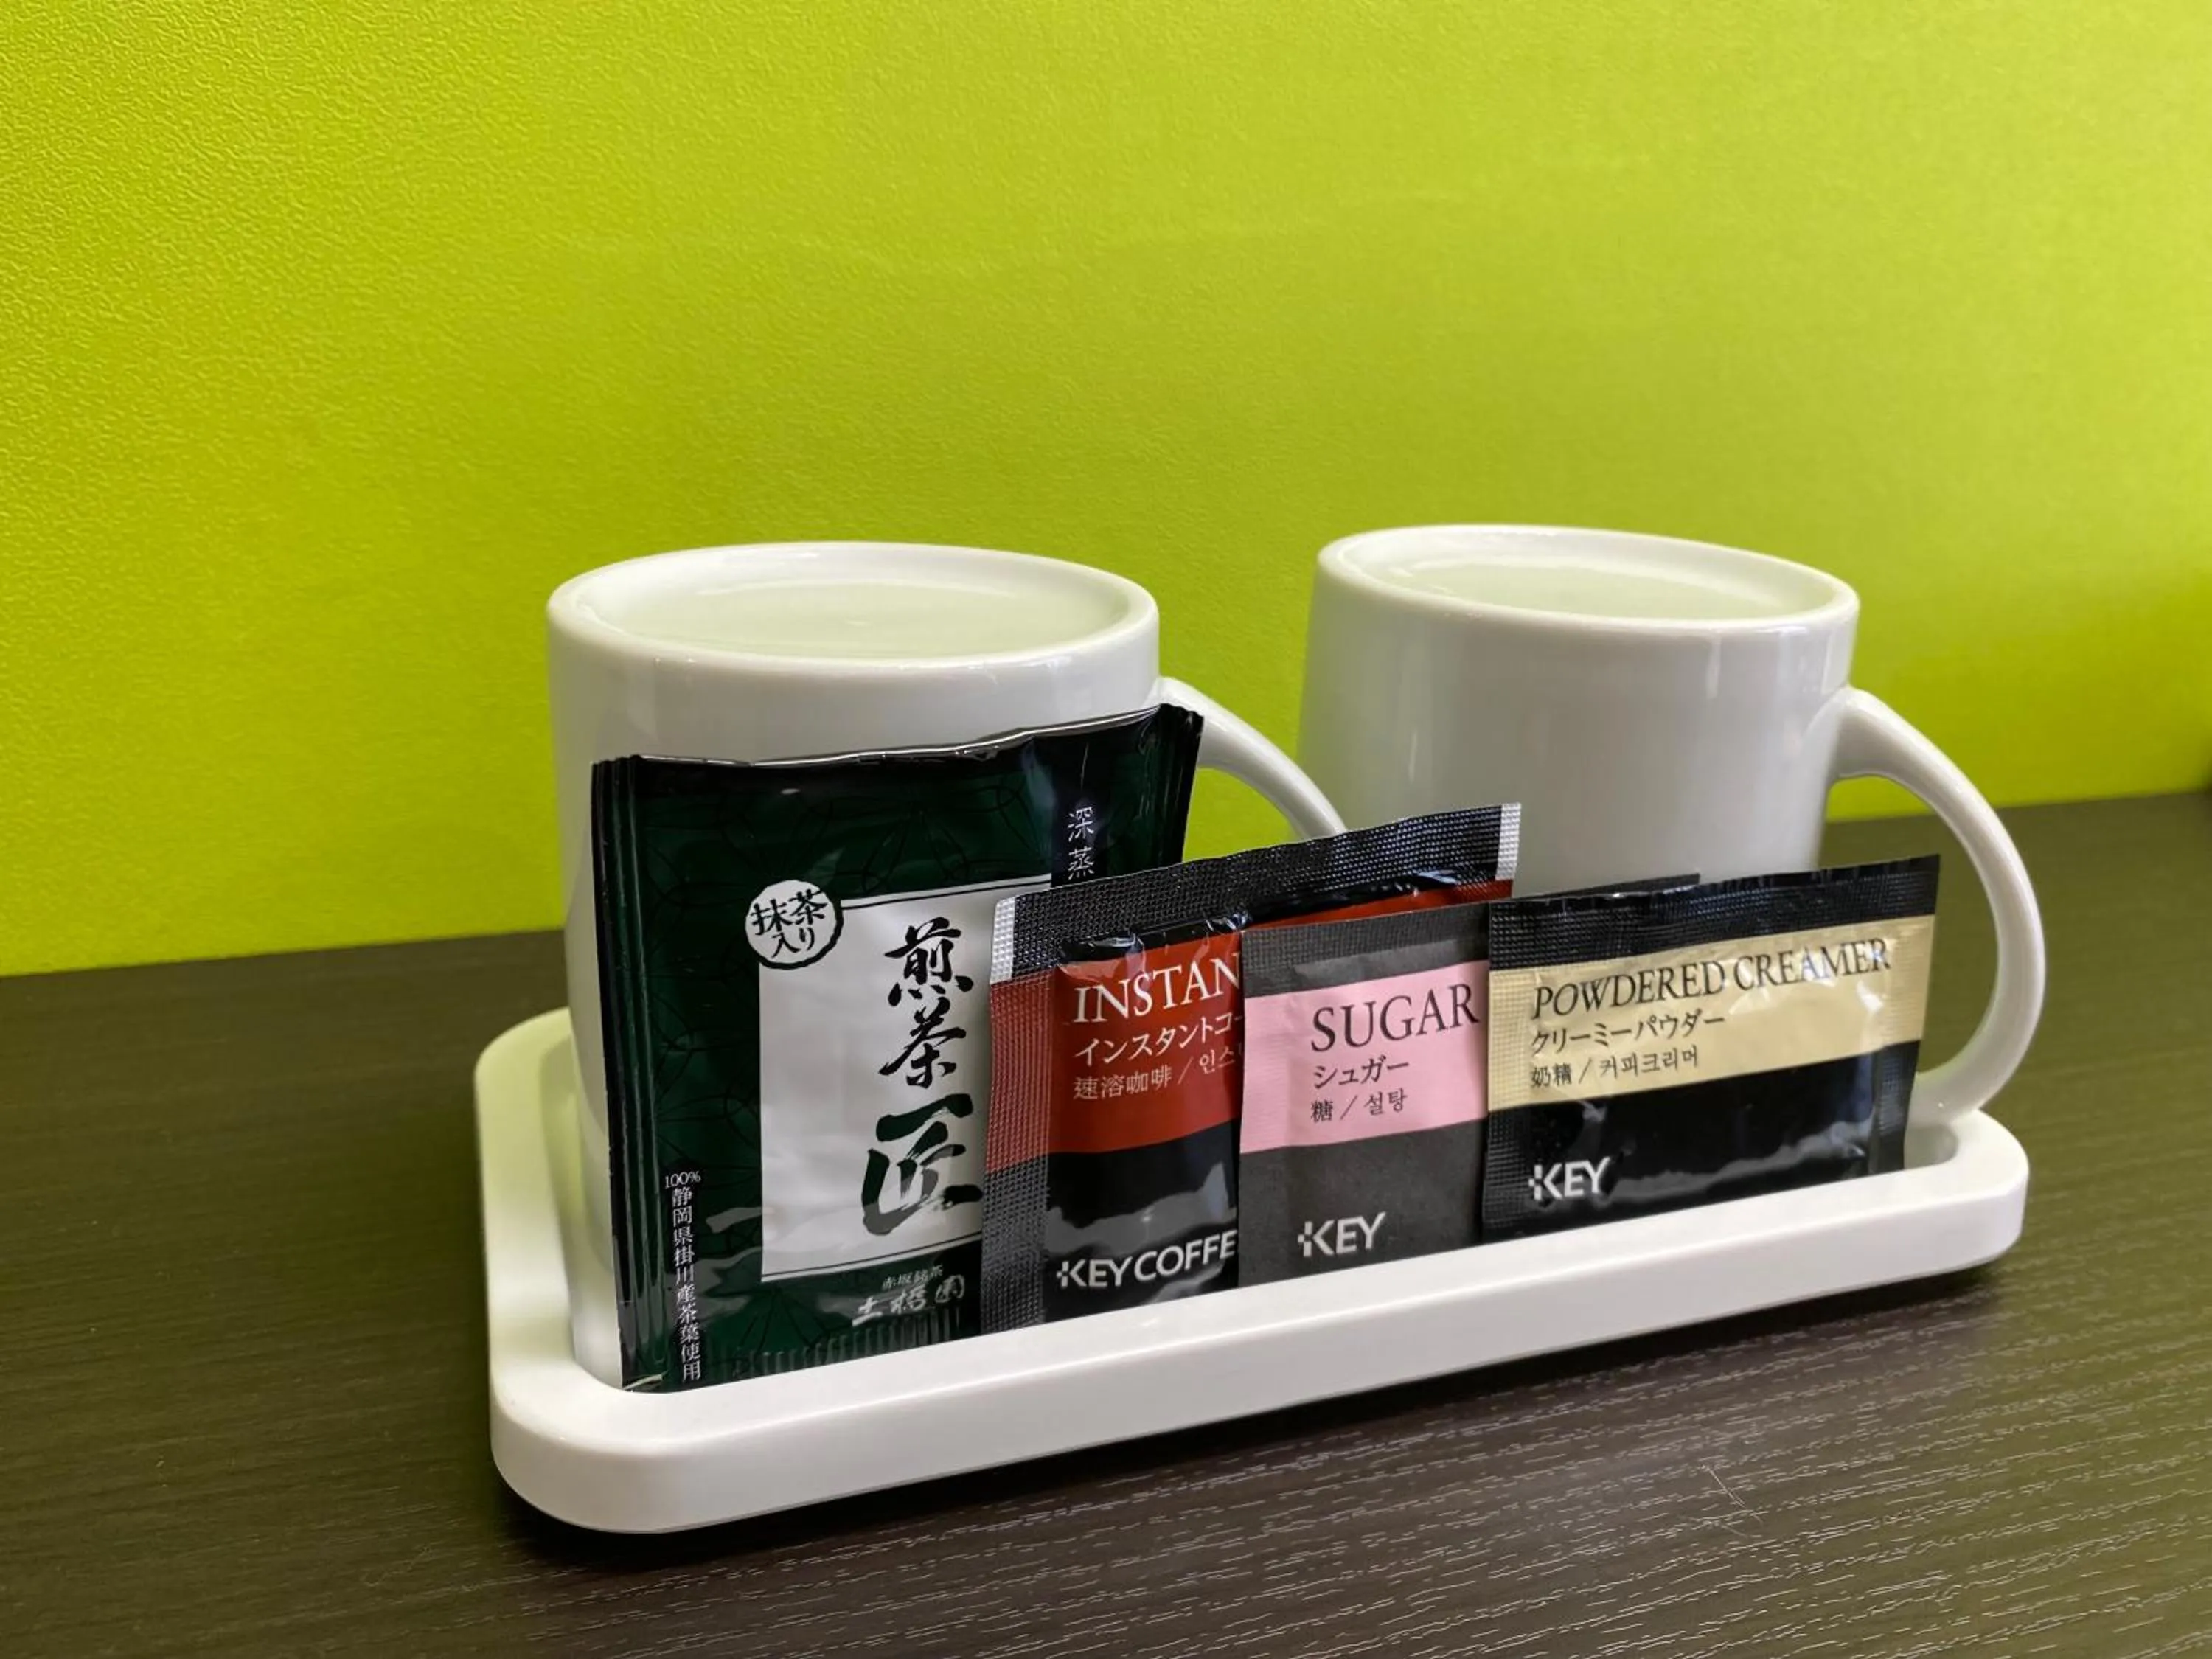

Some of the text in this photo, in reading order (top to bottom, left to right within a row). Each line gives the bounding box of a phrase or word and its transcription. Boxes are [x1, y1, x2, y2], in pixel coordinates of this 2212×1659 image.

[750, 888, 827, 936] 抹茶
[771, 927, 815, 958] 入り
[1073, 953, 1240, 1023] INSTAN
[1532, 938, 1893, 1020] POWDERED CREAMER
[1311, 983, 1480, 1053] SUGAR
[1531, 1008, 1725, 1054] クリーミーパウダー
[1073, 1064, 1172, 1100] 速溶咖啡
[1199, 1042, 1242, 1074] 인스
[1314, 1054, 1410, 1090] シュガー
[1530, 1062, 1572, 1088] 奶精
[1599, 1044, 1700, 1079] 커피크리머
[1310, 1099, 1334, 1122] 糖
[1364, 1087, 1408, 1116] 설탕
[665, 1171, 701, 1189] 100%
[1528, 1156, 1611, 1201] KEY
[1297, 1211, 1388, 1258] KEY
